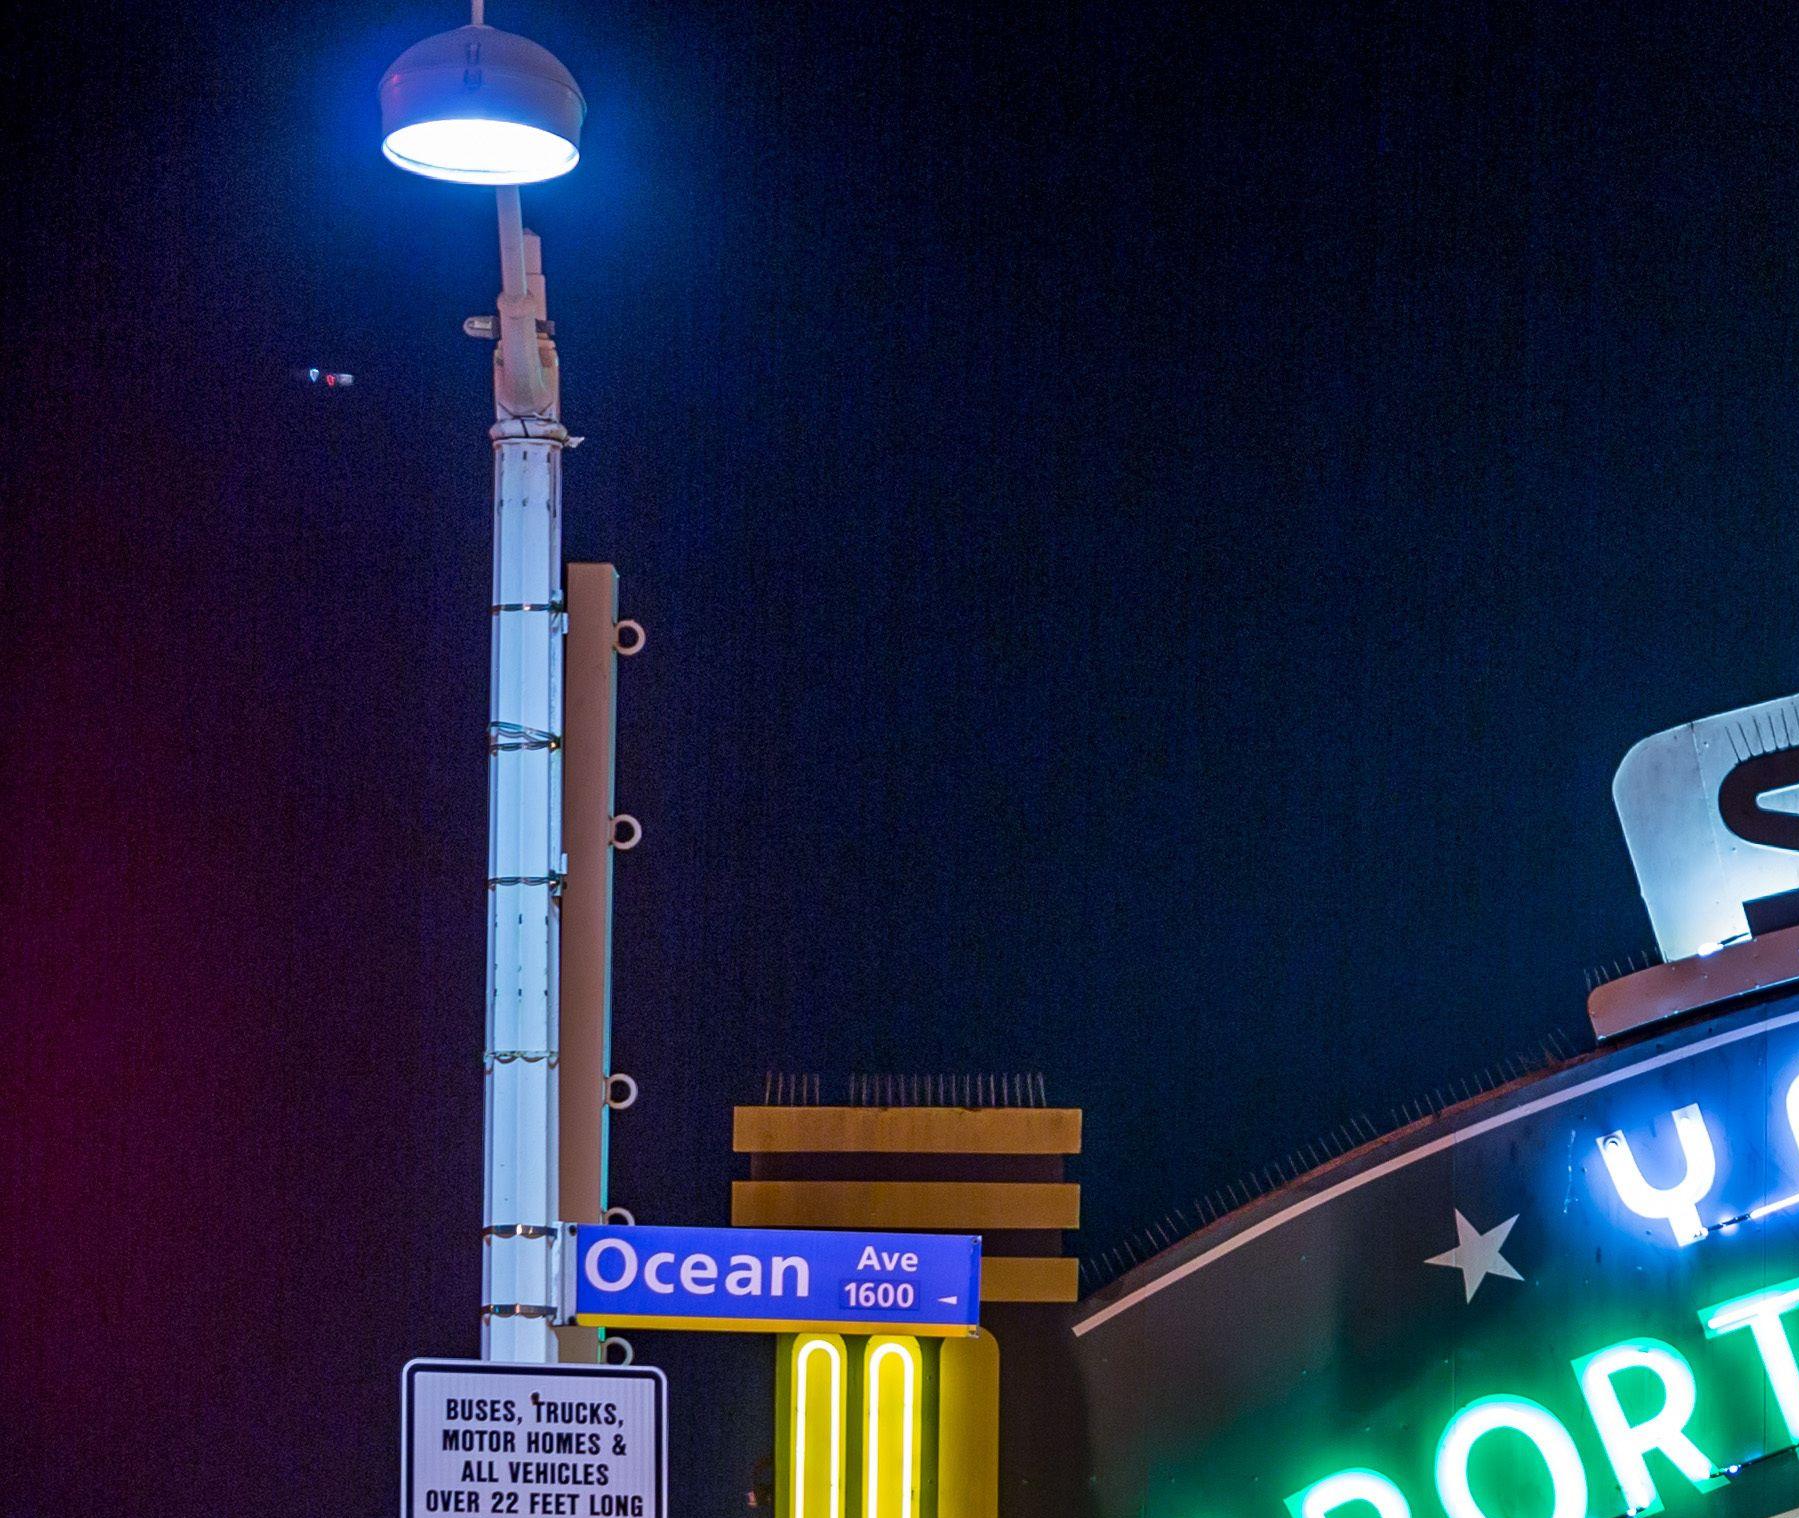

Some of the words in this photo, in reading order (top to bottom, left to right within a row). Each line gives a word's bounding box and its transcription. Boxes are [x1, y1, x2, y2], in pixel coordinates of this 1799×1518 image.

[585, 1238, 809, 1297] Ocean
[857, 1246, 919, 1272] Ave
[844, 1282, 914, 1308] 1600
[446, 1398, 523, 1426] BUSES,
[536, 1402, 624, 1427] TRUCKS,
[442, 1430, 516, 1453] MOTOR
[527, 1432, 600, 1455] HOMES
[612, 1434, 626, 1455] &
[461, 1461, 499, 1482] ALL
[509, 1462, 609, 1485] VEHICLES
[426, 1490, 480, 1513] OVER
[490, 1492, 519, 1514] 22
[529, 1493, 579, 1515] FEET
[590, 1495, 643, 1517] LONG
